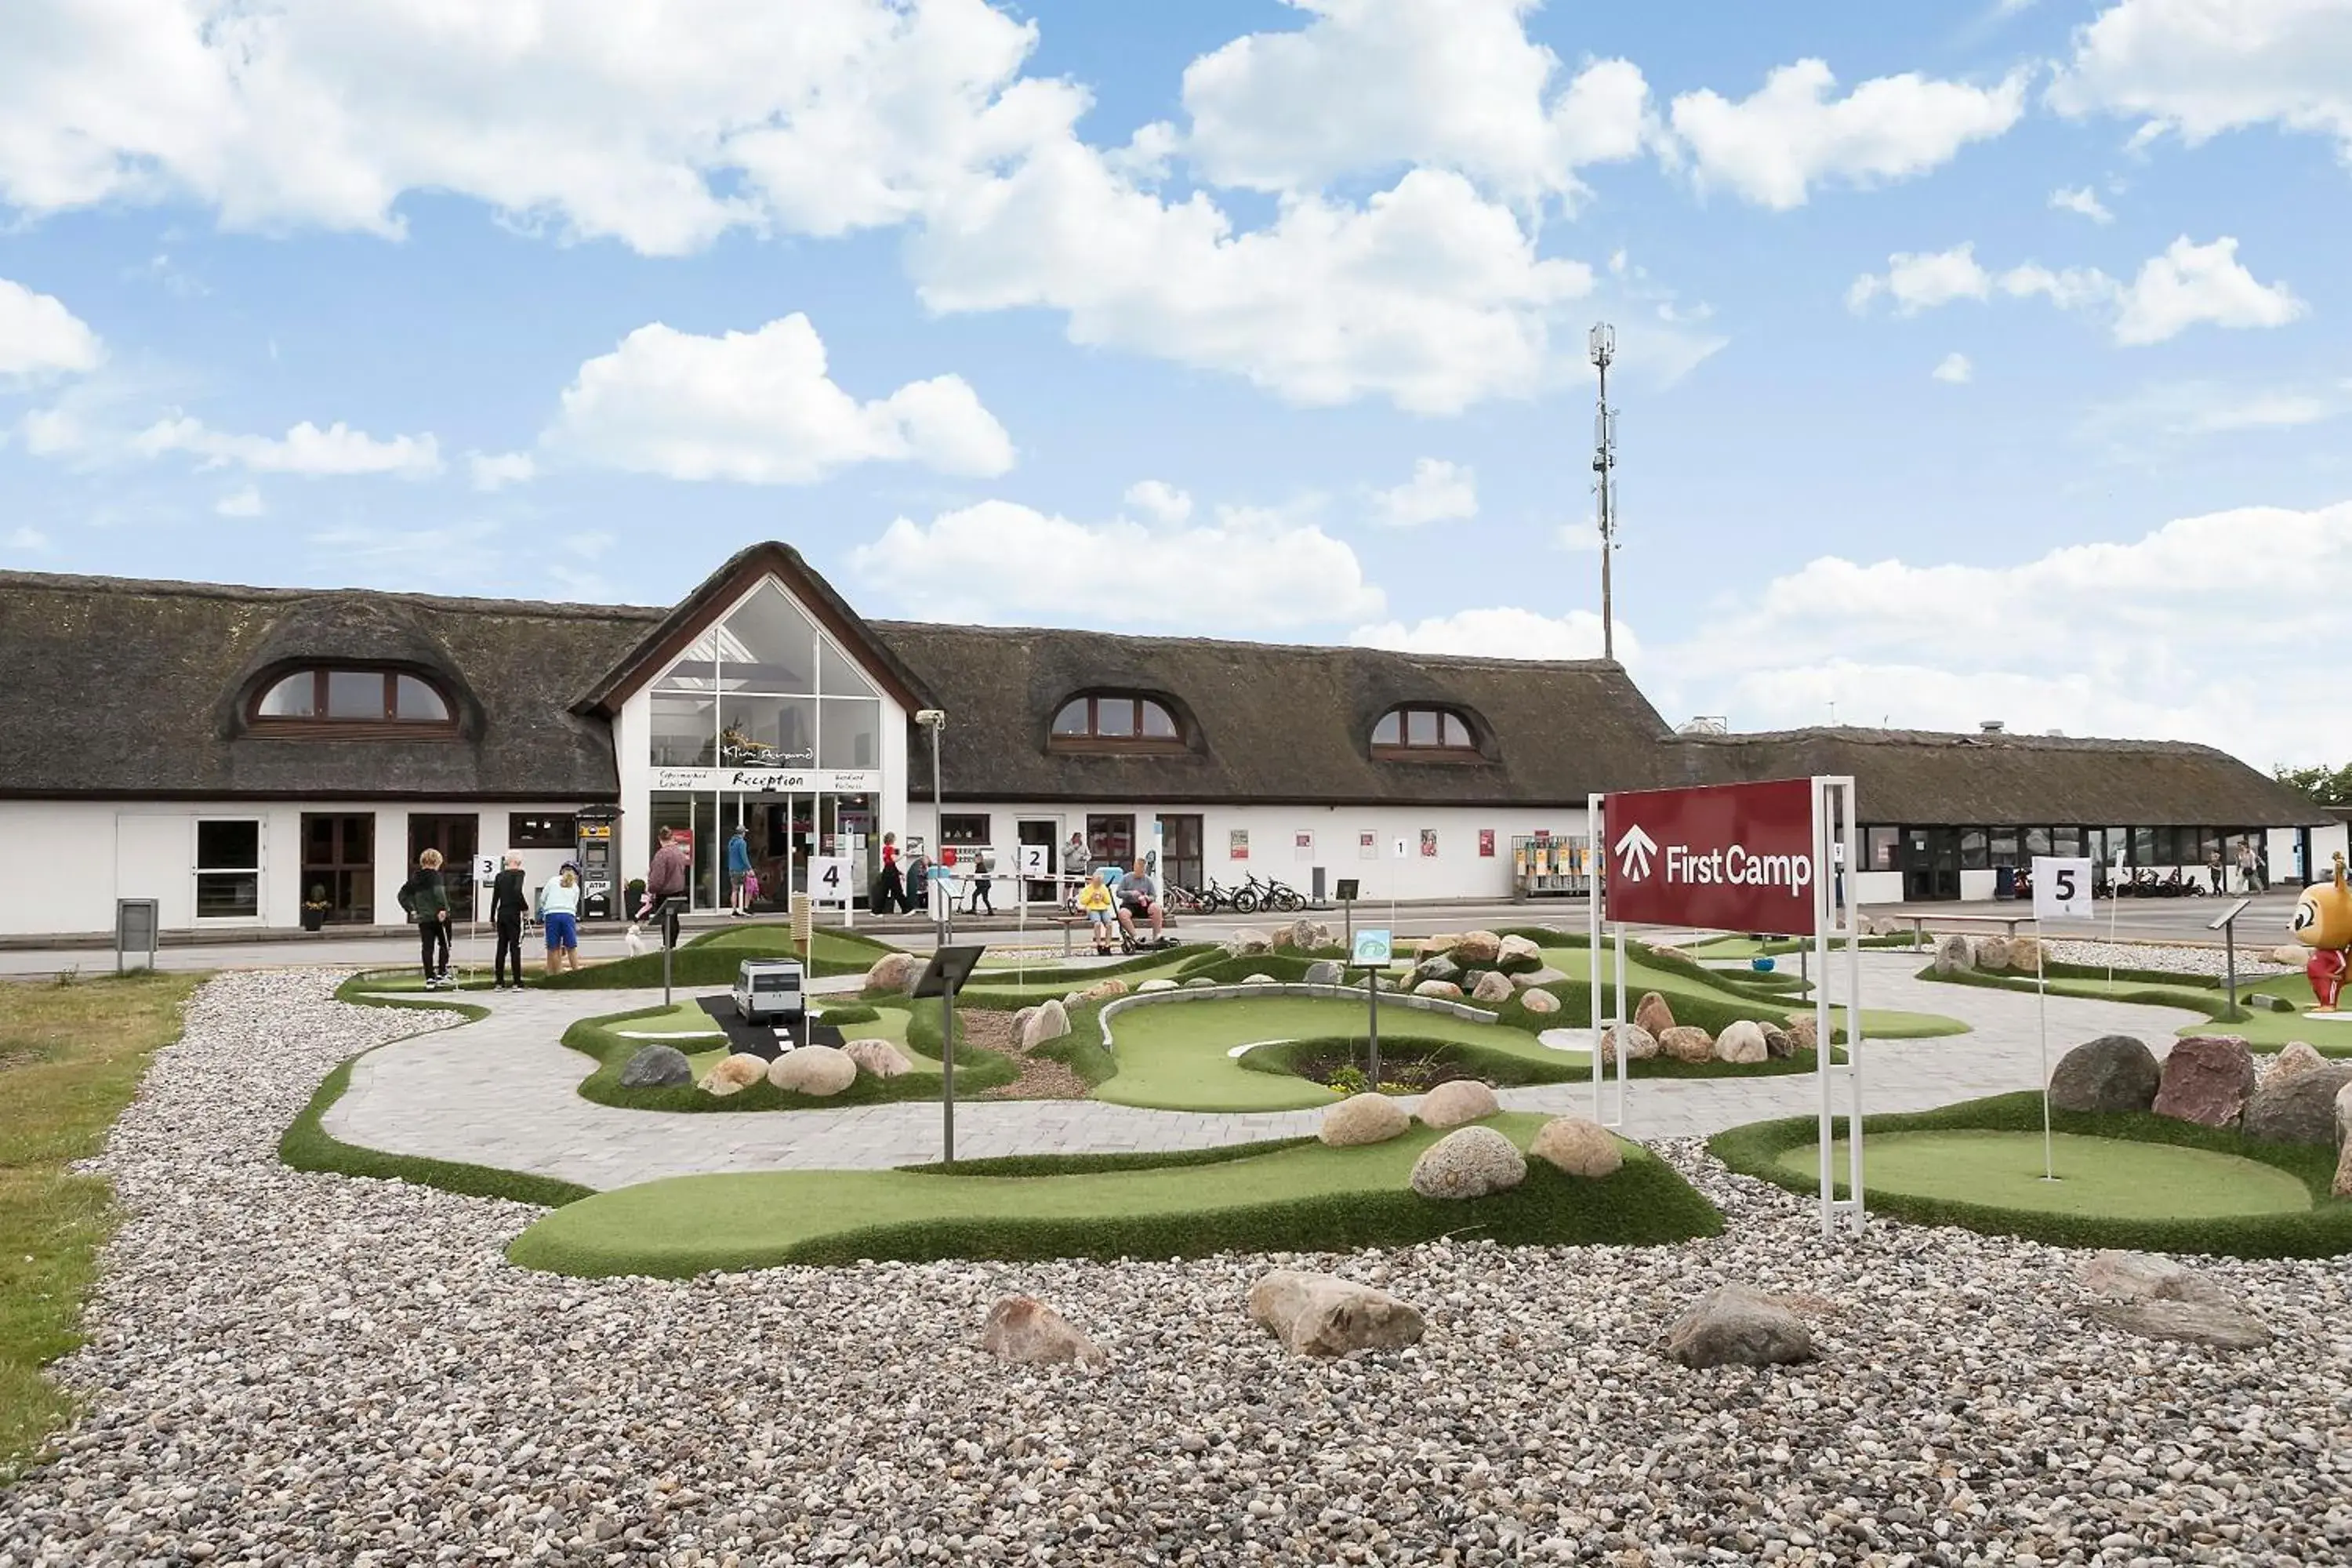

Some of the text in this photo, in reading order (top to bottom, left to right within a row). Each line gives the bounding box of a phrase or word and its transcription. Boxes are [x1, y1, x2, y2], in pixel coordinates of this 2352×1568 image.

[733, 771, 804, 787] Reception
[1398, 841, 1403, 854] 1
[483, 860, 493, 873] 3
[1029, 851, 1040, 866] 2
[822, 865, 840, 888] 4
[1667, 844, 1812, 897] First Camp
[2056, 869, 2075, 901] 5
